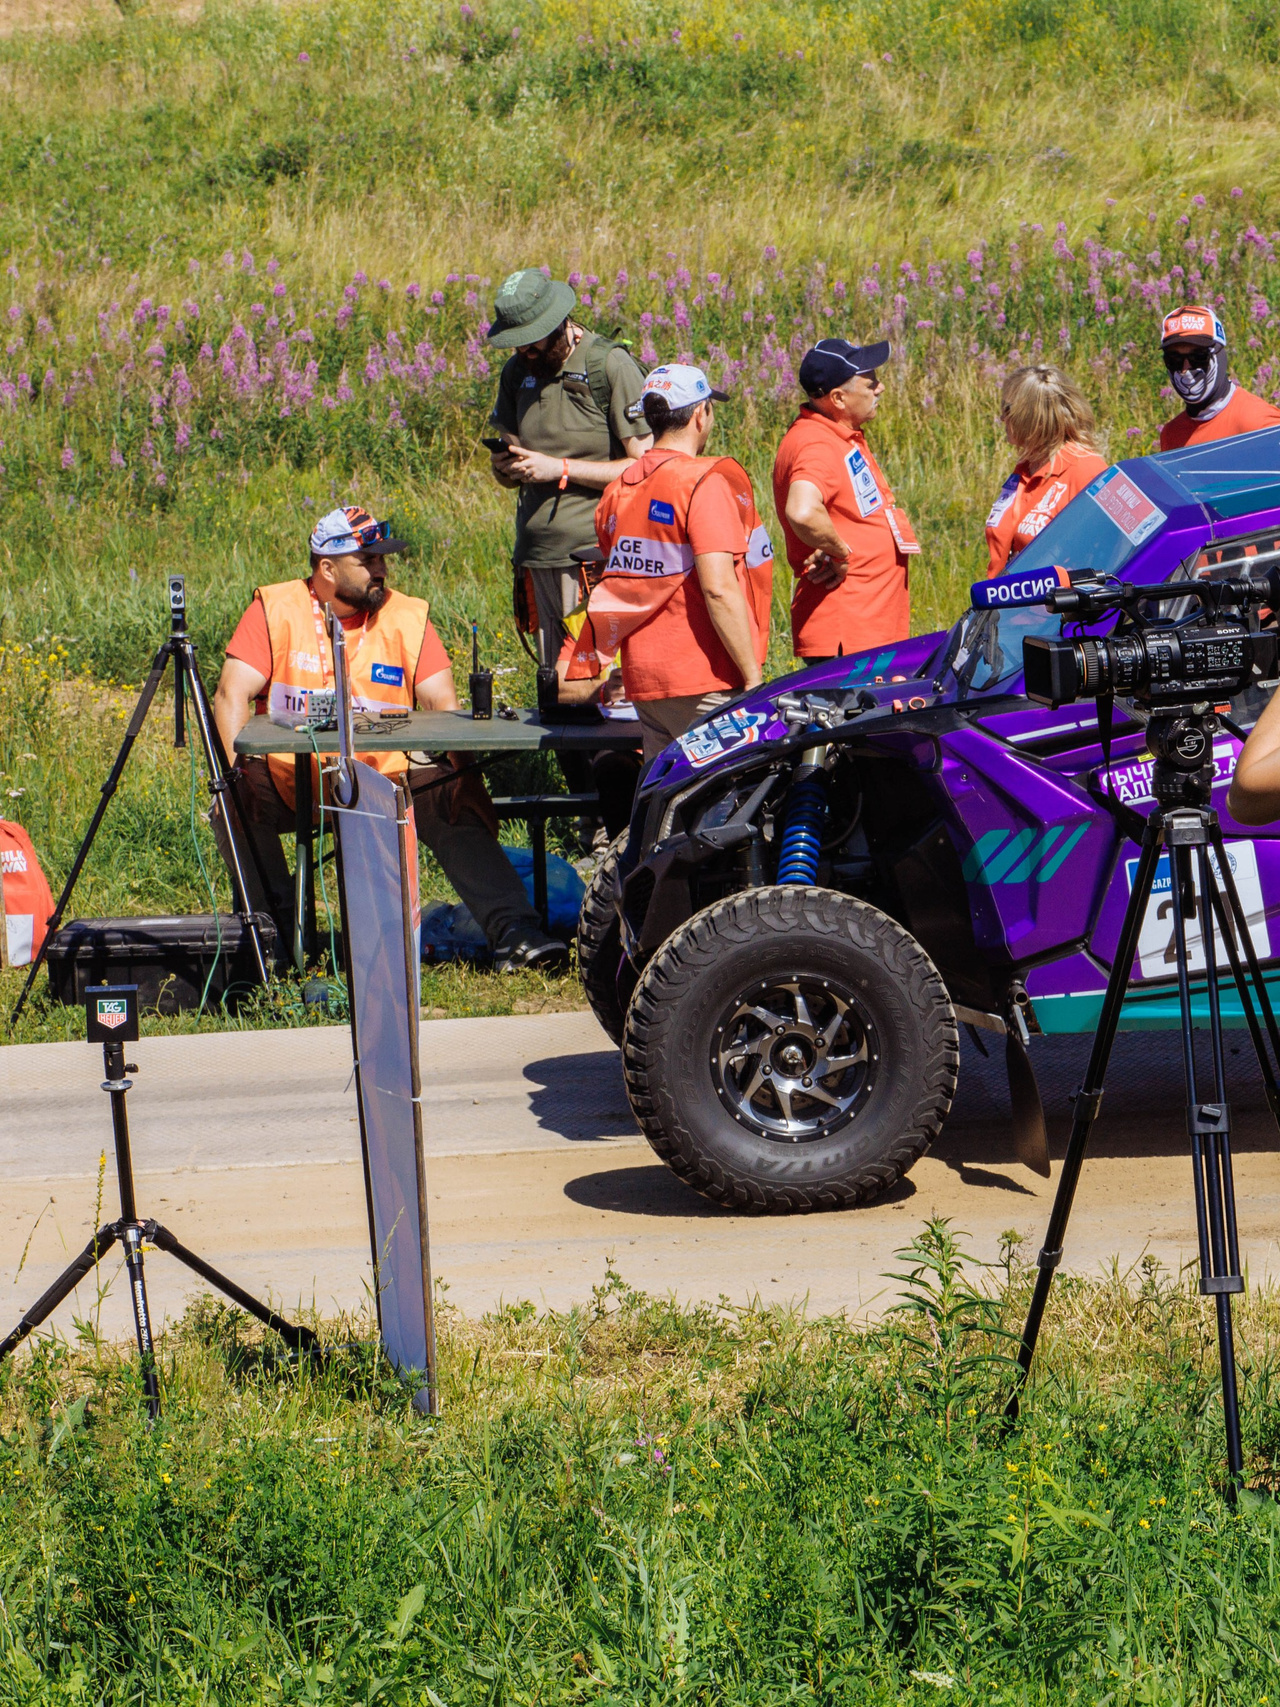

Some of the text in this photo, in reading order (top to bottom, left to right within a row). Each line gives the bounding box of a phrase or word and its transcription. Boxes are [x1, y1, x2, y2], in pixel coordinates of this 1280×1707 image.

[1182, 315, 1205, 323] SILK
[1182, 322, 1205, 330] WAY
[986, 577, 1056, 604] РОССИЯ
[1216, 627, 1241, 635] SONY
[1152, 877, 1172, 890] GAZP
[102, 1002, 122, 1013] TAG
[101, 1014, 125, 1026] HEUER
[133, 1280, 147, 1327] Manfrotto
